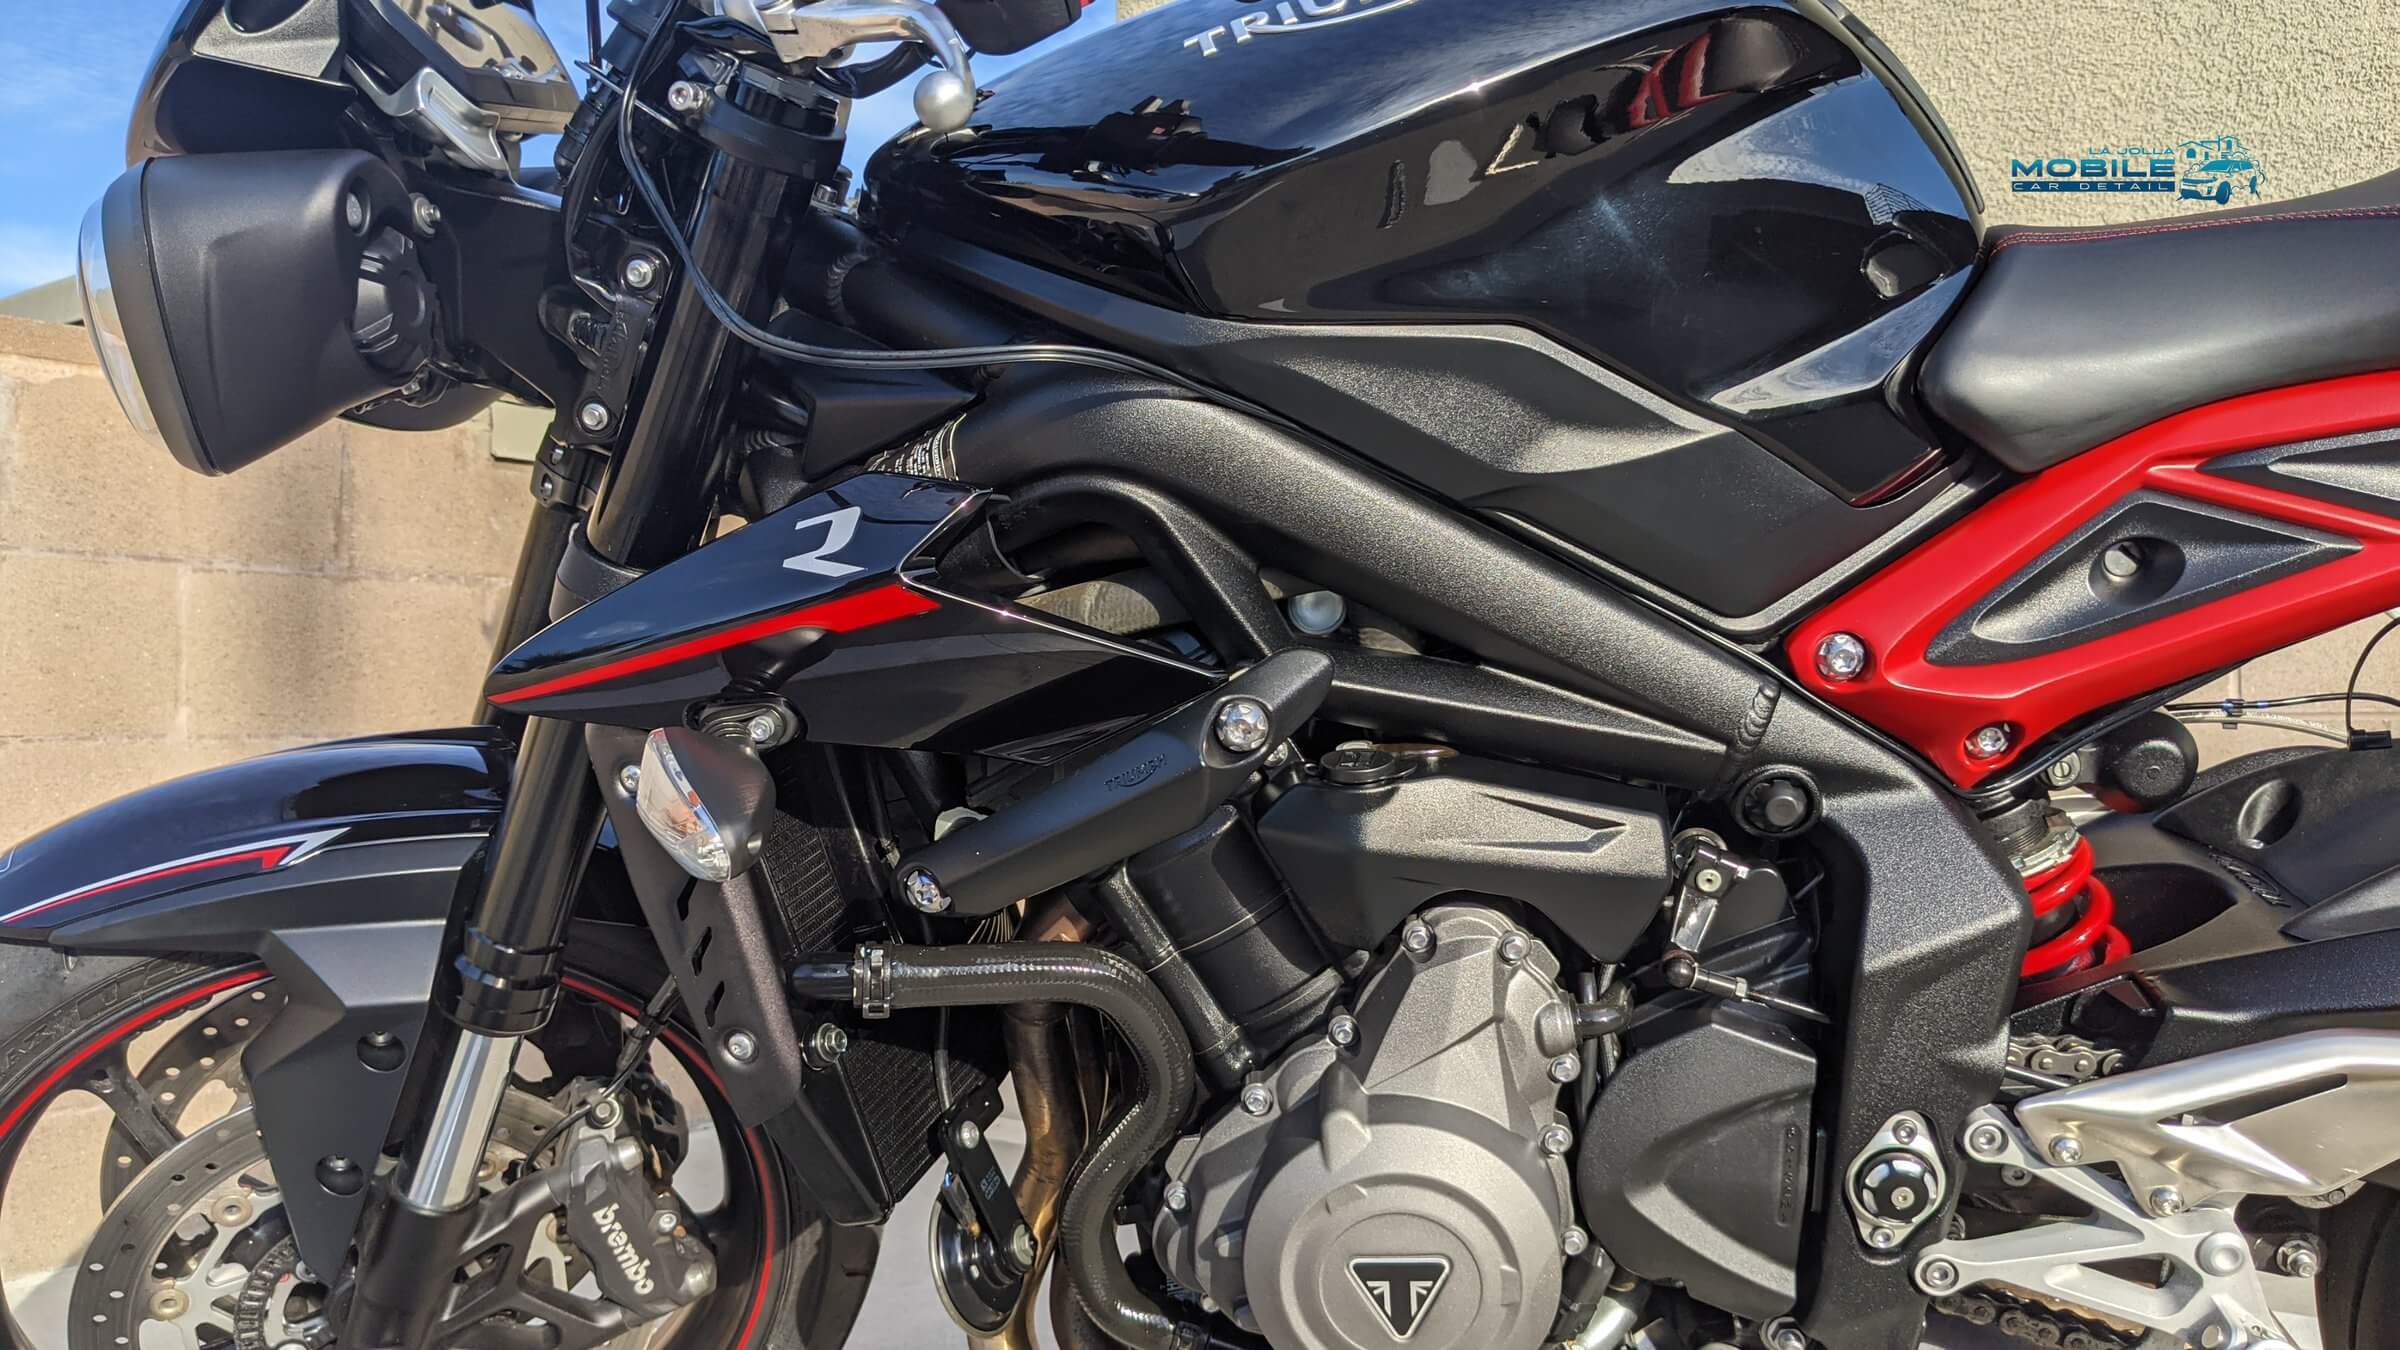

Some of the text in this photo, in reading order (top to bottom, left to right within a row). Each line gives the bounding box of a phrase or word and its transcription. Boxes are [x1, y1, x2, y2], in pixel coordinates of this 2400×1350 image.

[1183, 0, 1374, 56] TRIU
[1103, 752, 1168, 793] TRIUMPH
[592, 1202, 655, 1295] brembo
